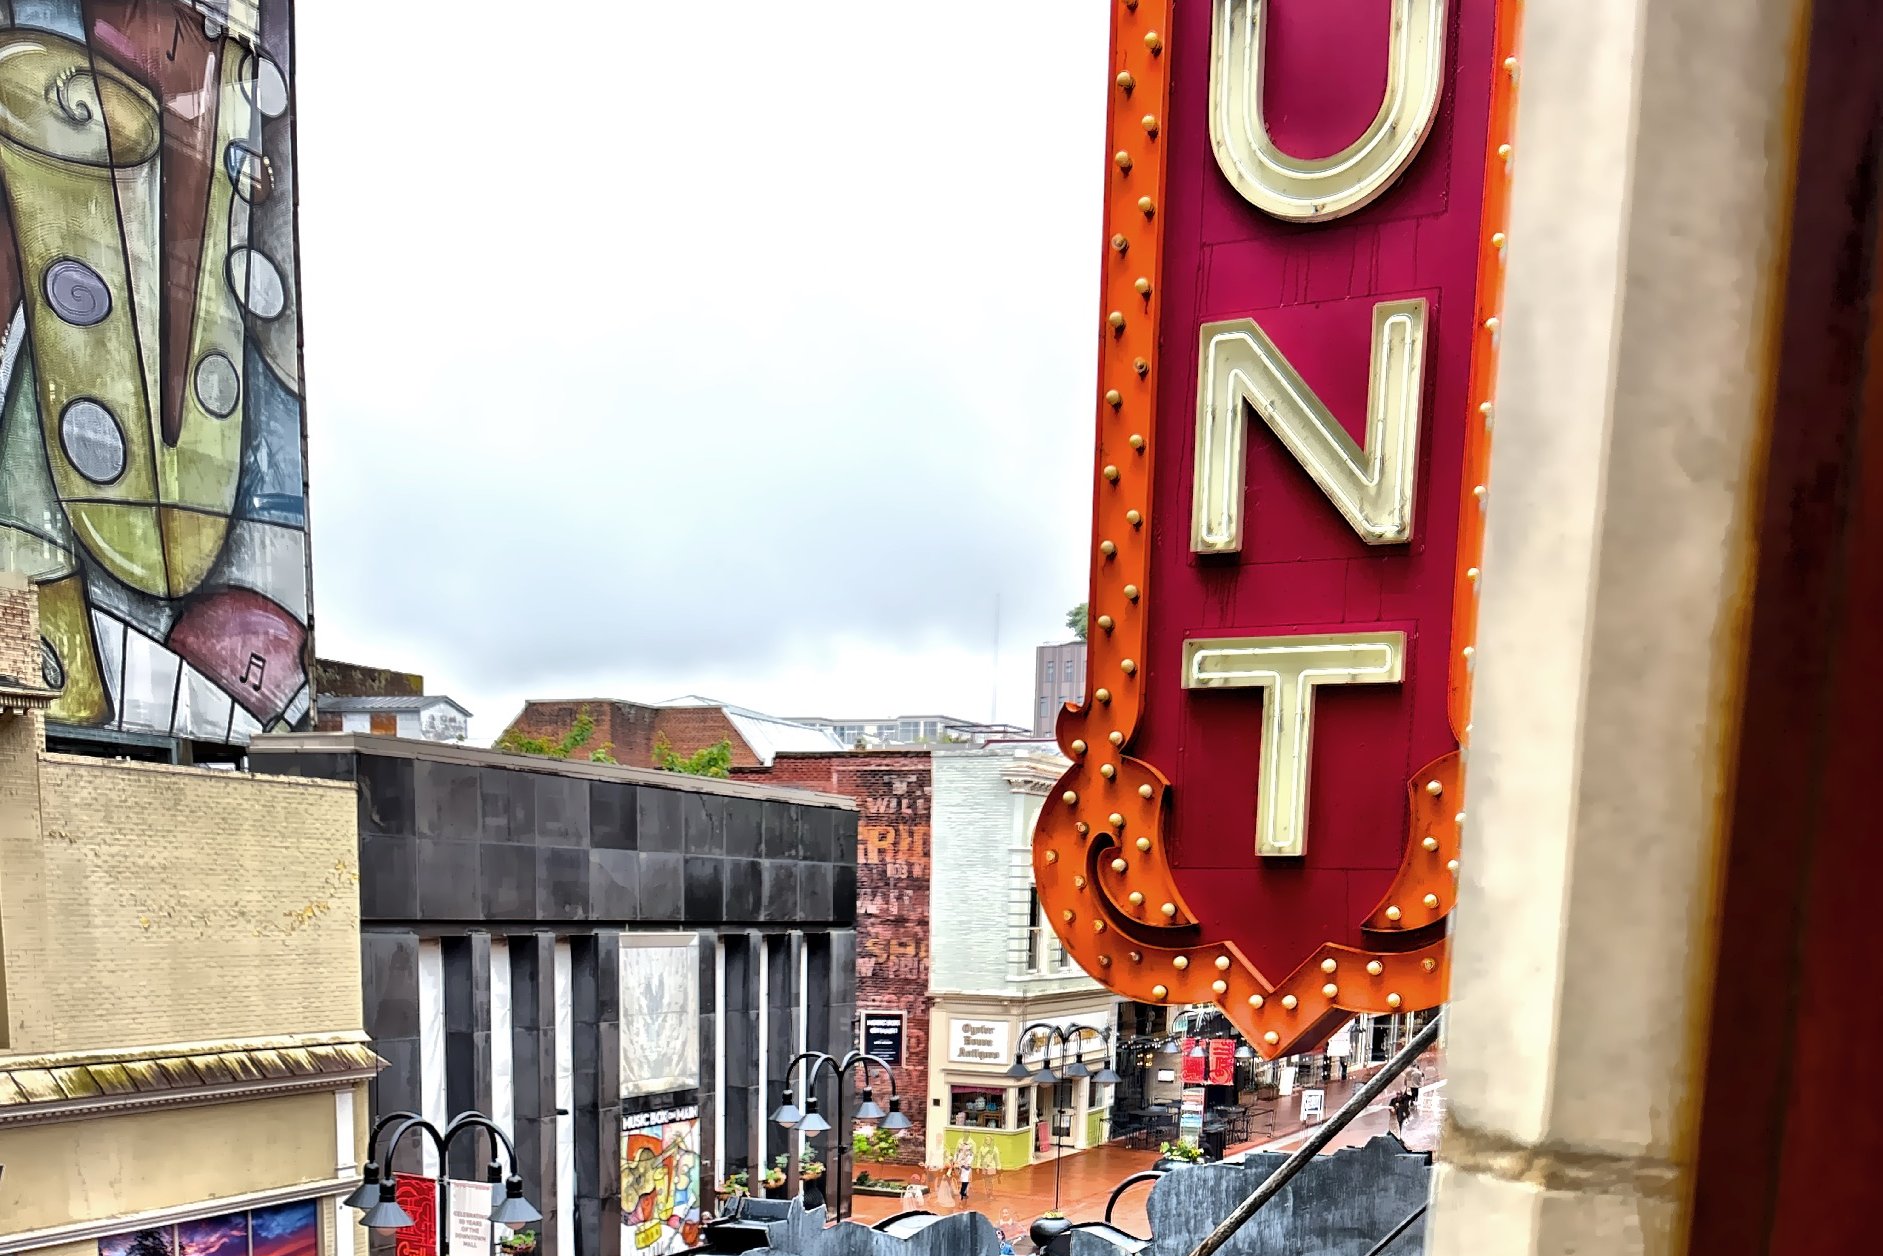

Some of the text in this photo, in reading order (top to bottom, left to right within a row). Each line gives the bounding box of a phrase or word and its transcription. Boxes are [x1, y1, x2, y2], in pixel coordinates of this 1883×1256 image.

[962, 1023, 995, 1035] Oyster
[957, 1047, 1000, 1060] Antiques
[623, 1112, 650, 1131] MUSIC
[650, 1110, 668, 1126] BOX
[676, 1105, 698, 1122] MAIN
[455, 1232, 486, 1242] DOWNTOWN
